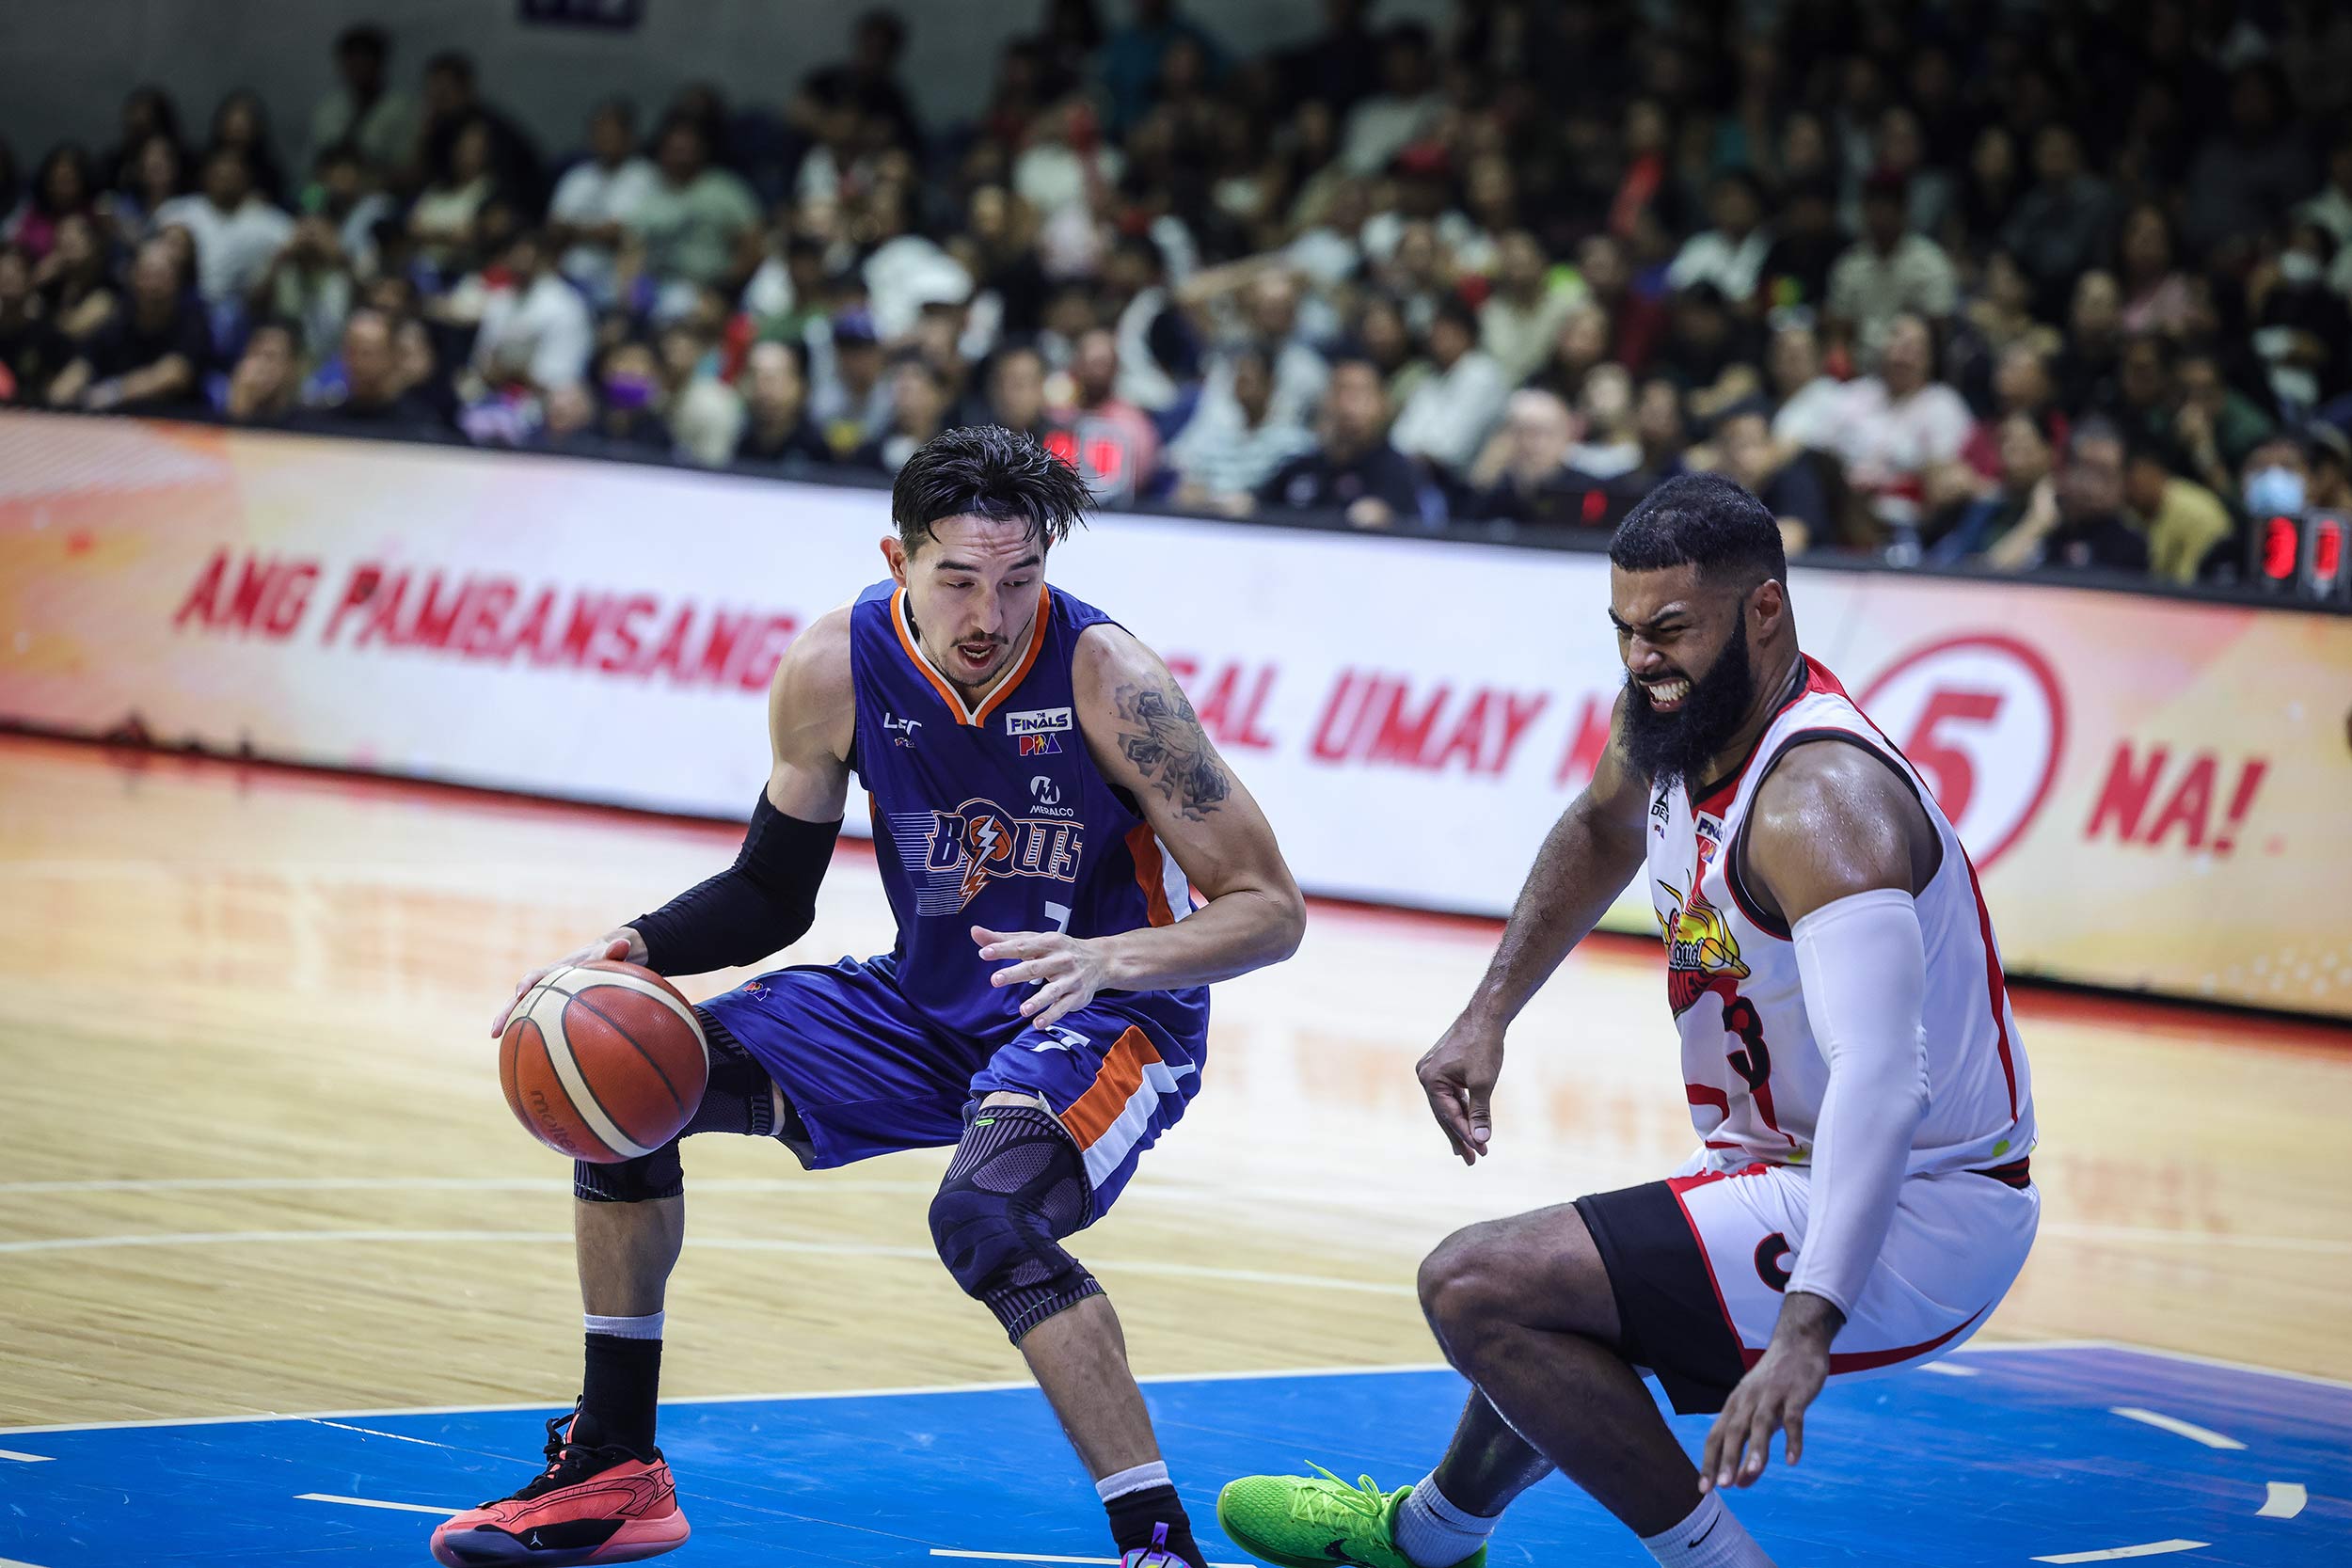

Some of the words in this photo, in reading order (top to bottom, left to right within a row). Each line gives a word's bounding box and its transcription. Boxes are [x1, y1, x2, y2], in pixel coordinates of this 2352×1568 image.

[173, 546, 321, 641] ANG
[321, 560, 797, 693] PAMBANSANG
[1309, 665, 1550, 777] UMAY
[1906, 689, 2005, 830] 5
[2083, 739, 2269, 857] NA!
[1010, 713, 1068, 733] FINALS
[1019, 733, 1063, 756] PBA
[1029, 804, 1074, 817] MERALCO
[925, 798, 1085, 883] BOLTS
